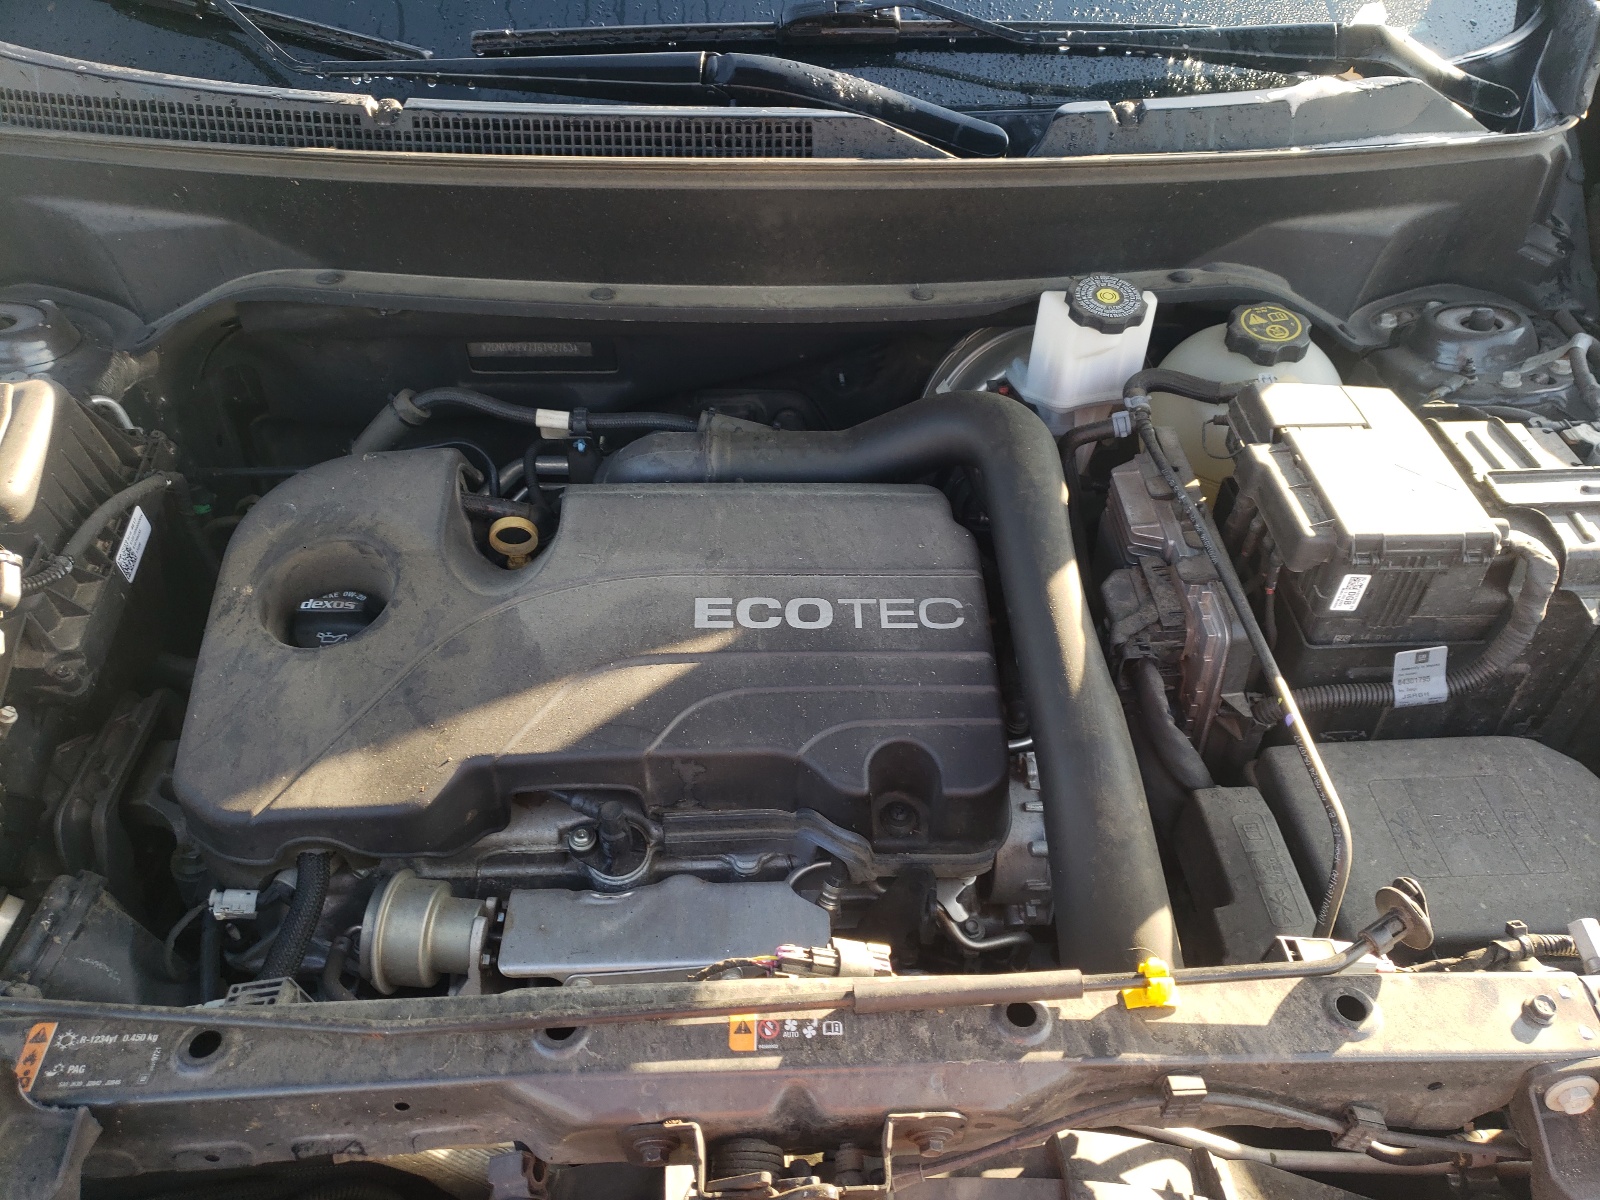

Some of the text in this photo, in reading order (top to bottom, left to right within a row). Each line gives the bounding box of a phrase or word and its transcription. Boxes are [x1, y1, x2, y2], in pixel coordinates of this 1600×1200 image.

[300, 598, 356, 610] dexos
[694, 597, 965, 629] ECOTEC
[79, 1033, 159, 1044] R-1234yf 0.450 kg
[67, 1064, 86, 1074] PAG
